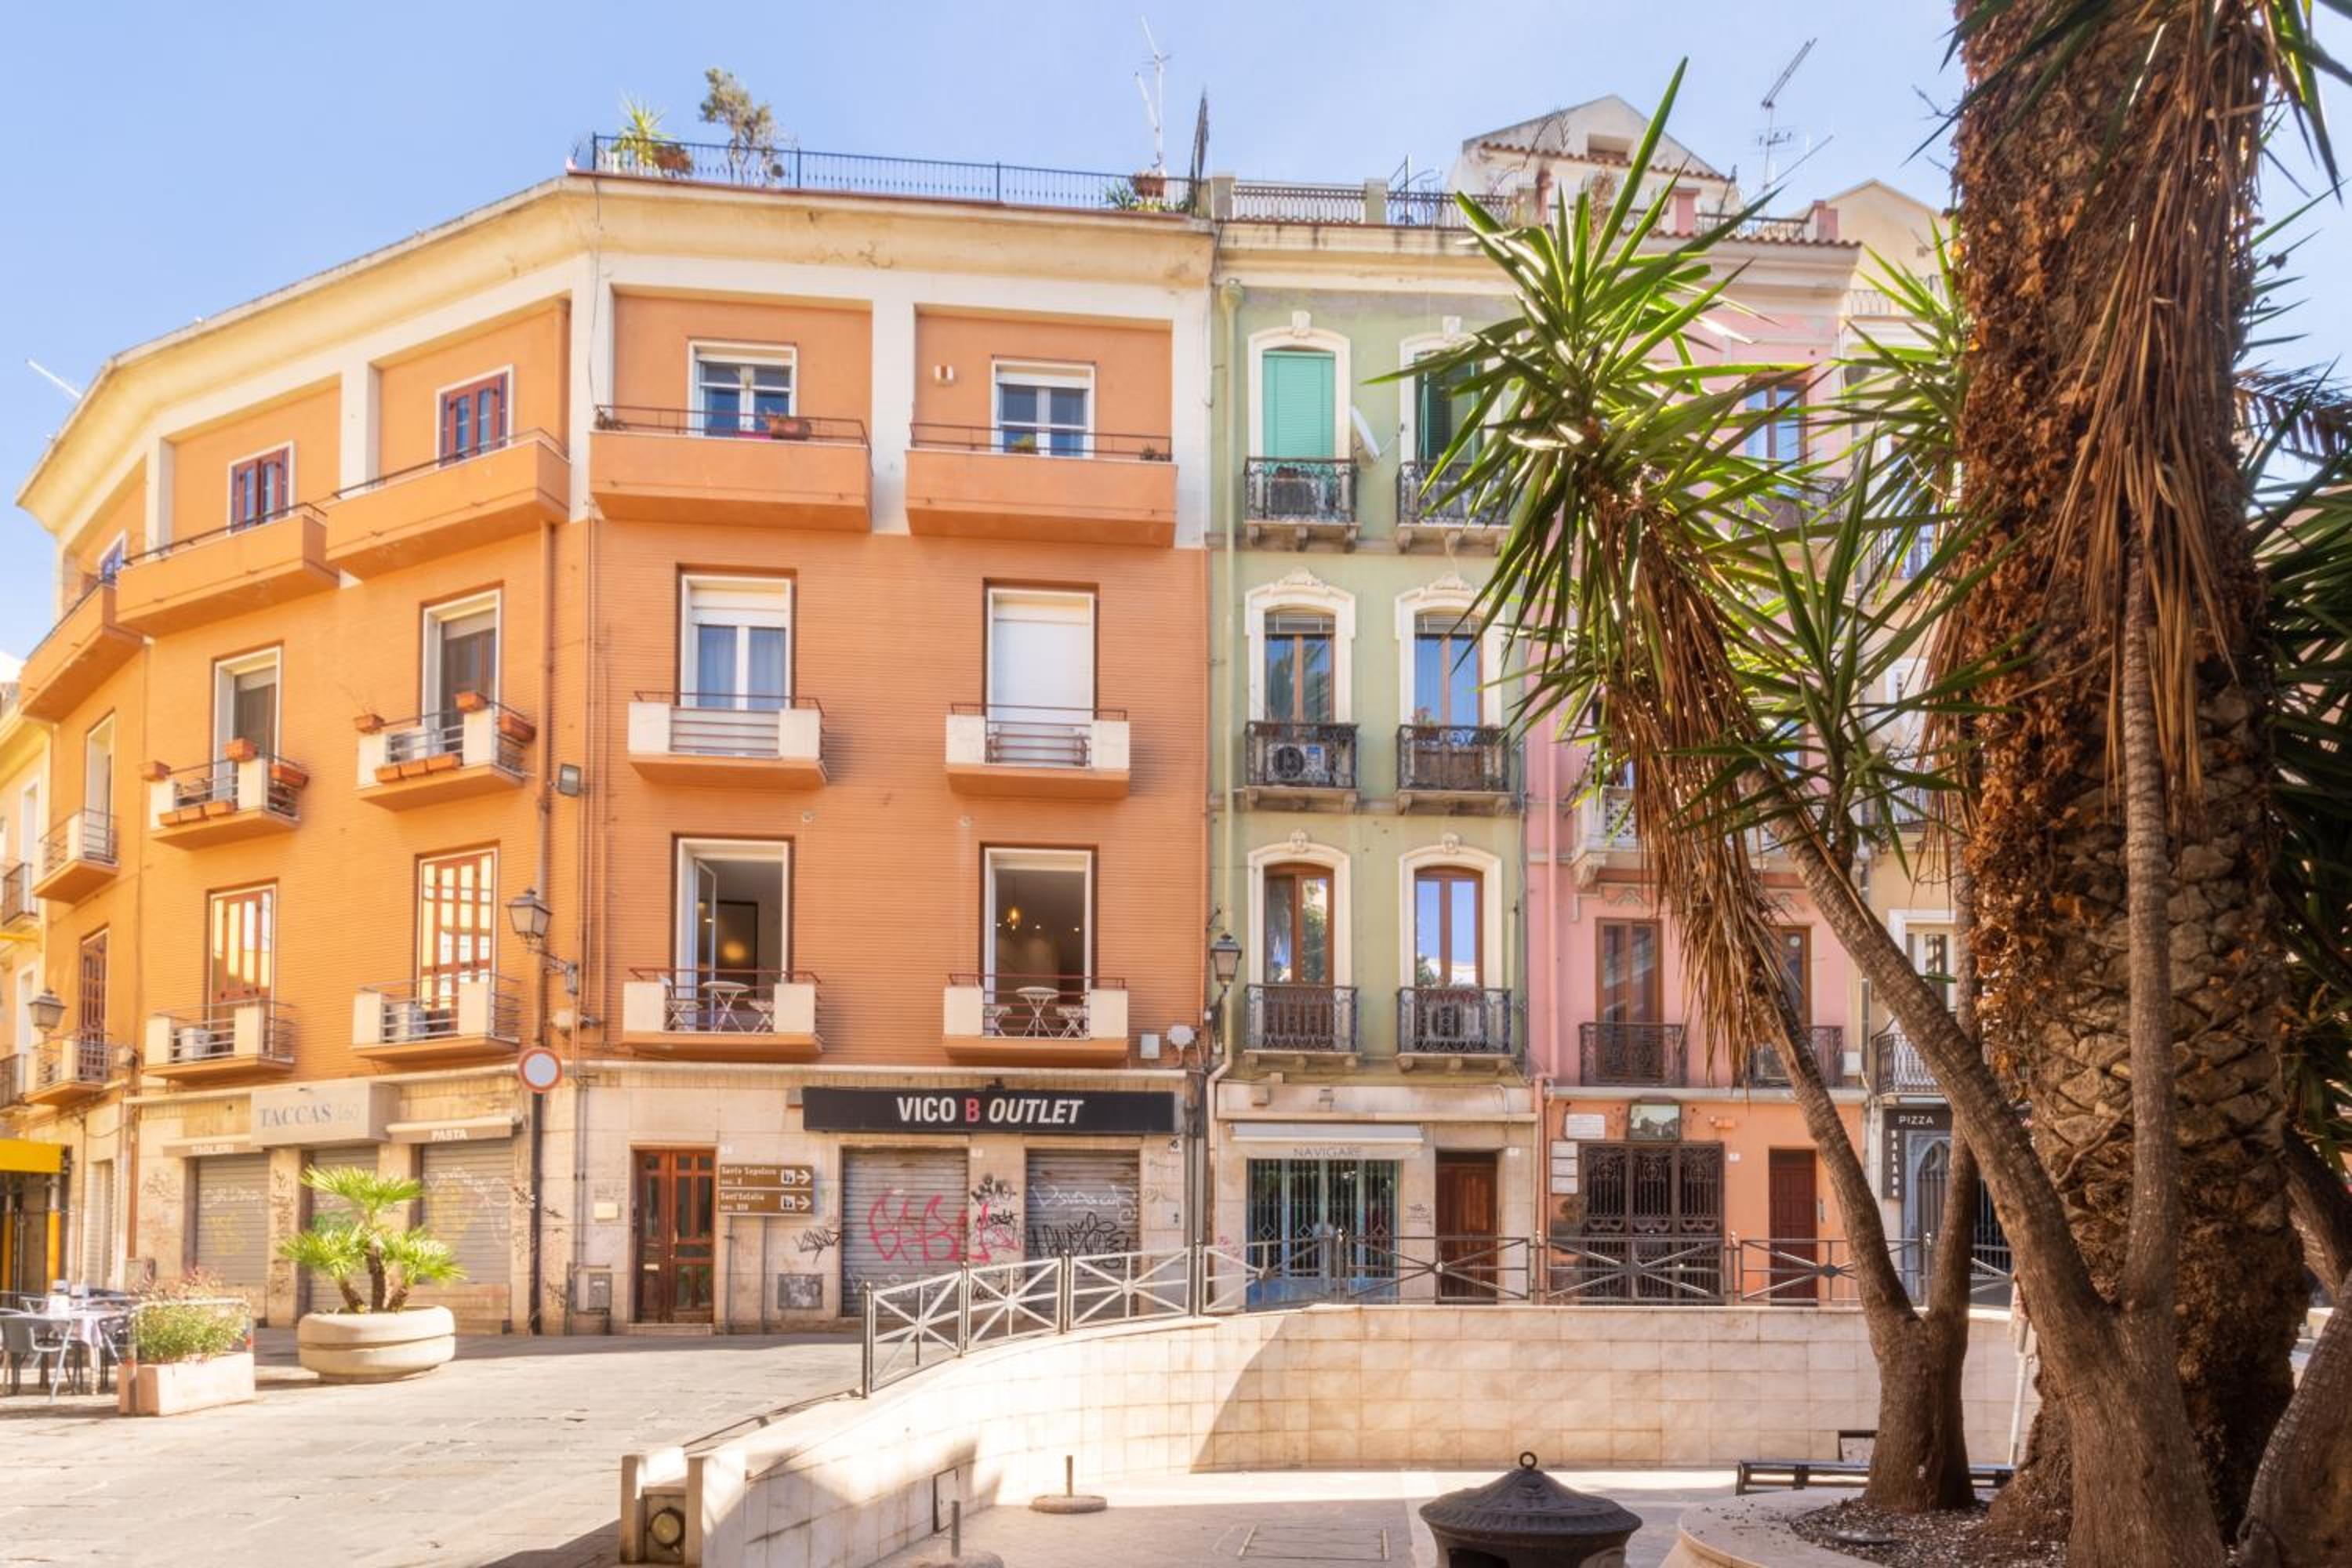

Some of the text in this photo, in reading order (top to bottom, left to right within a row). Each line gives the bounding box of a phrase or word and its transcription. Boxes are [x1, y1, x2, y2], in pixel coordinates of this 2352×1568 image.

[260, 1104, 332, 1127] TACCAS
[896, 1097, 1084, 1123] VICO B OUTLET
[1898, 1116, 1934, 1125] PIZZA
[431, 1129, 468, 1142] PASTA
[1294, 1147, 1362, 1158] NAVIGARE
